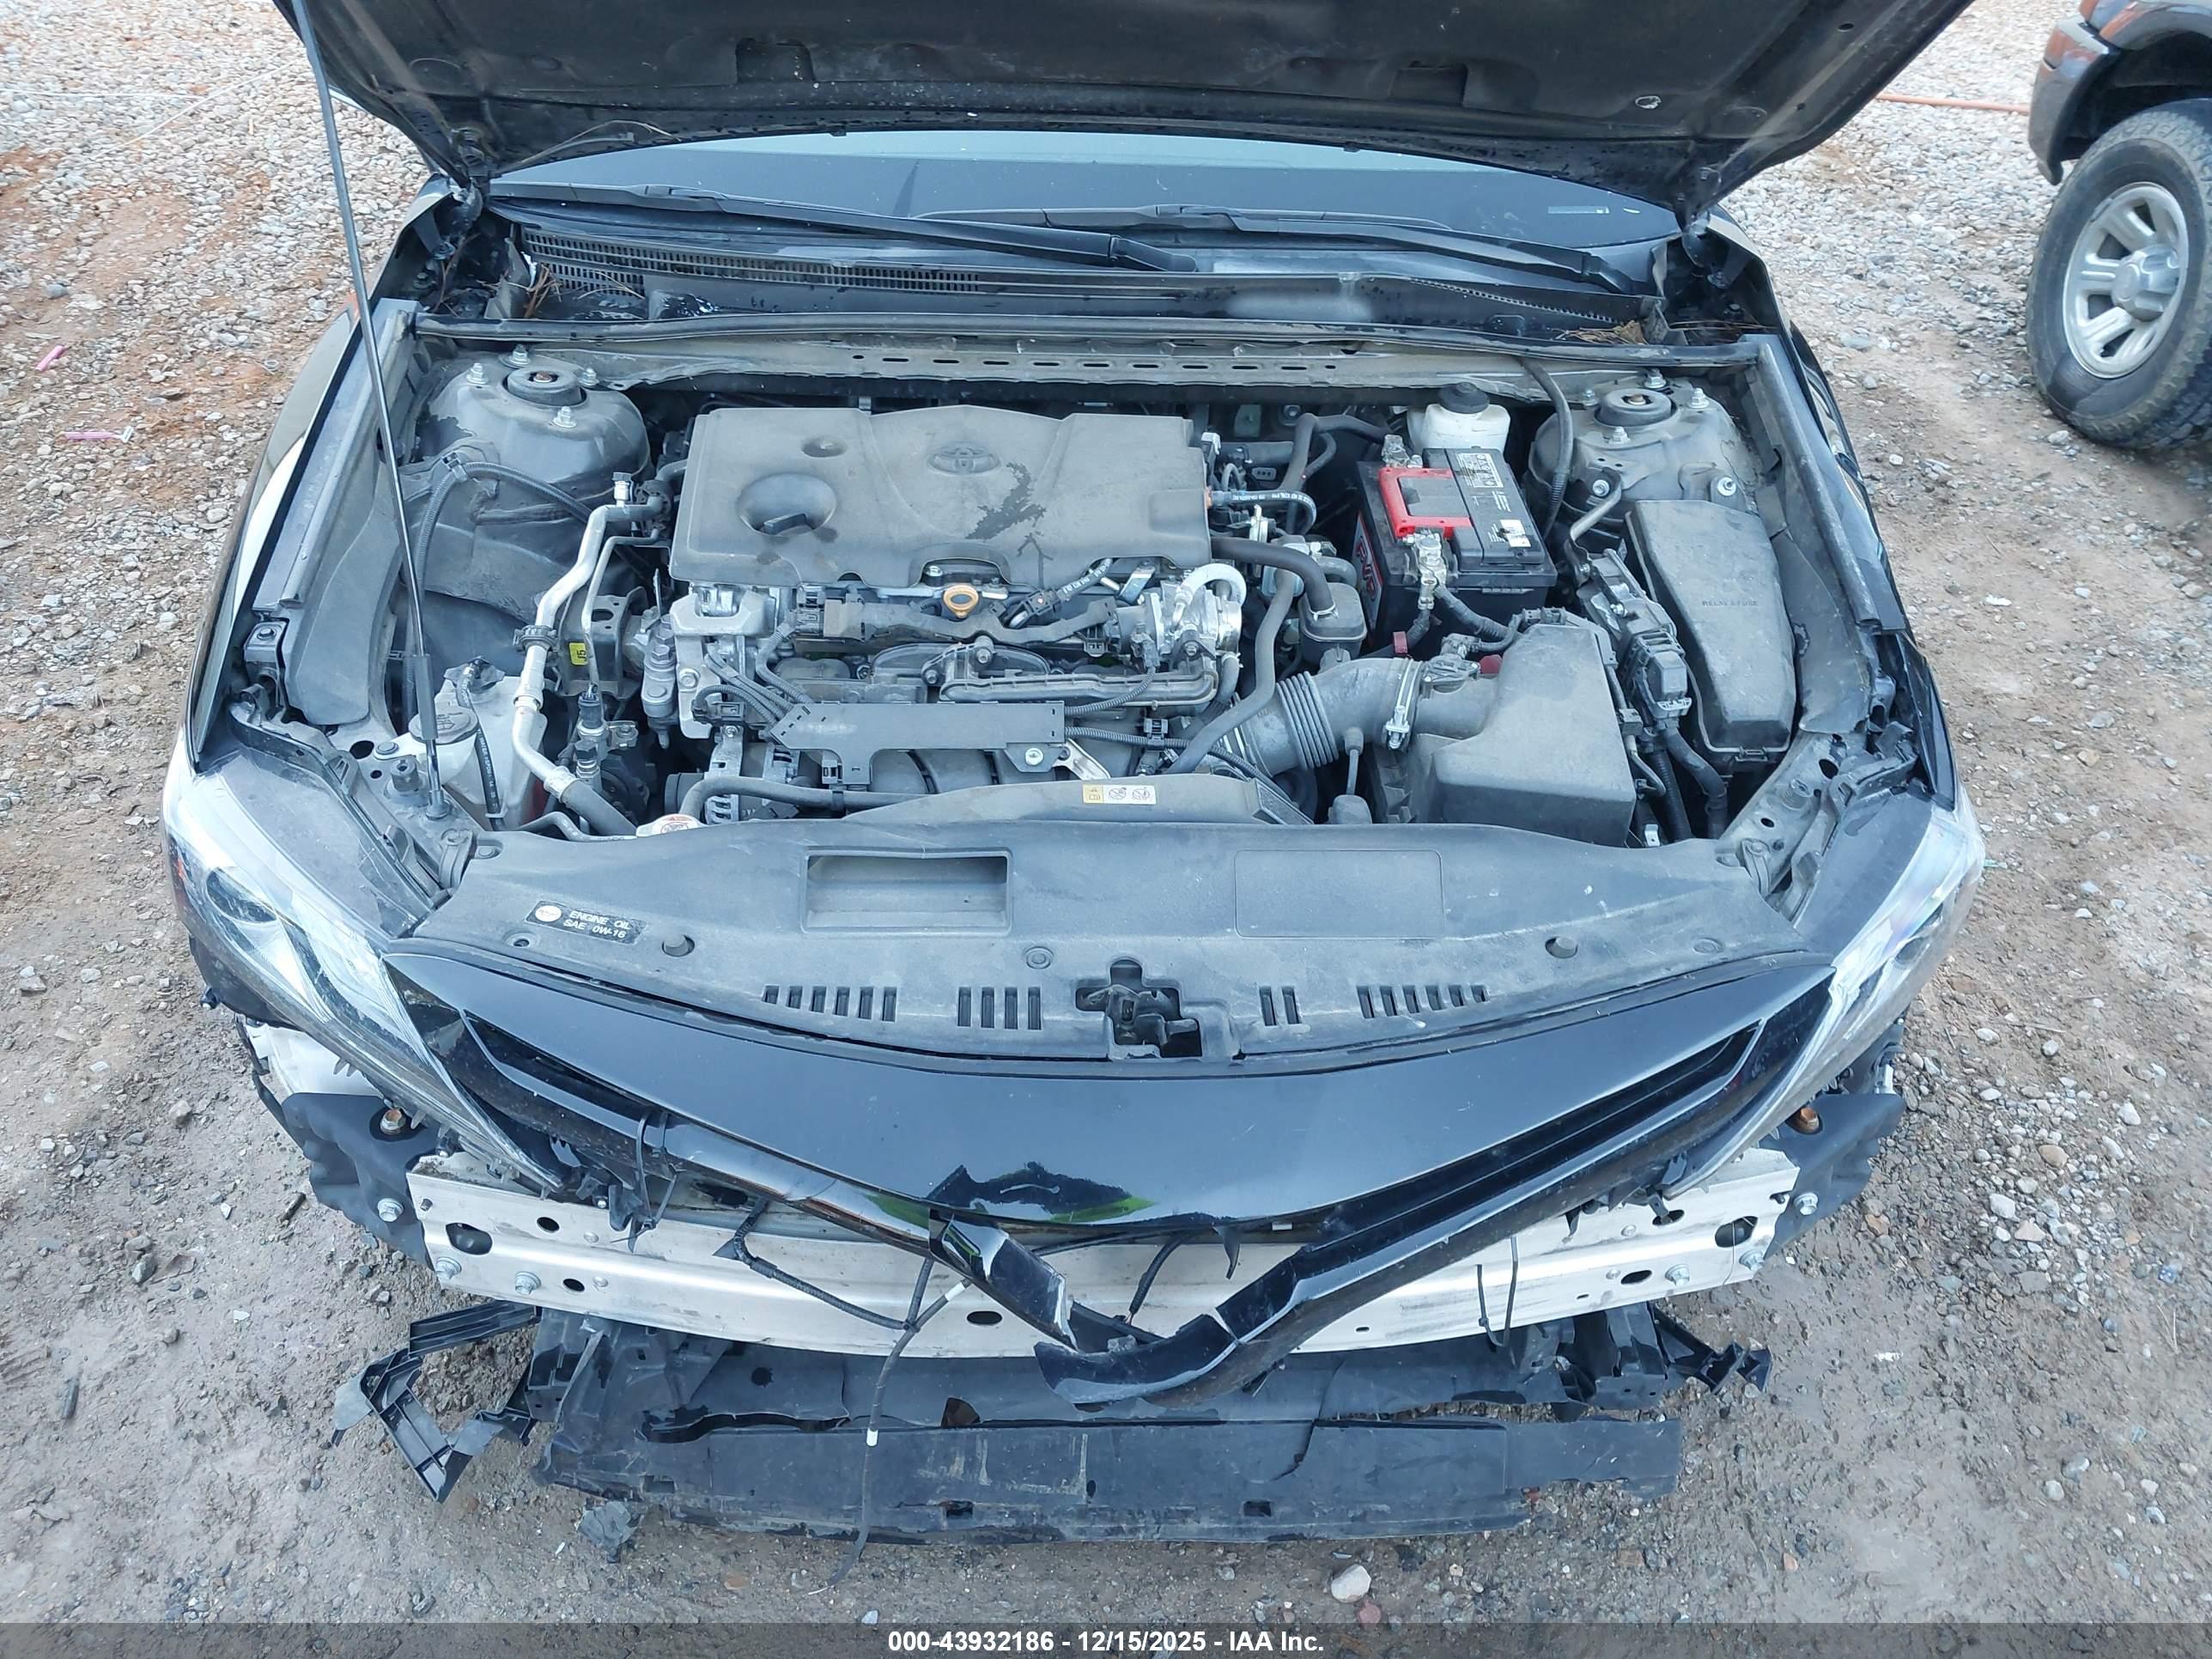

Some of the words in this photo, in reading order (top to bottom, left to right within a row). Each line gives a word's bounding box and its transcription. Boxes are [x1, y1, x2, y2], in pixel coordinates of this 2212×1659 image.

[563, 919, 586, 930] SAE
[592, 925, 627, 939] 0W-16
[568, 910, 610, 925] ENGINE
[614, 920, 632, 930] OIL
